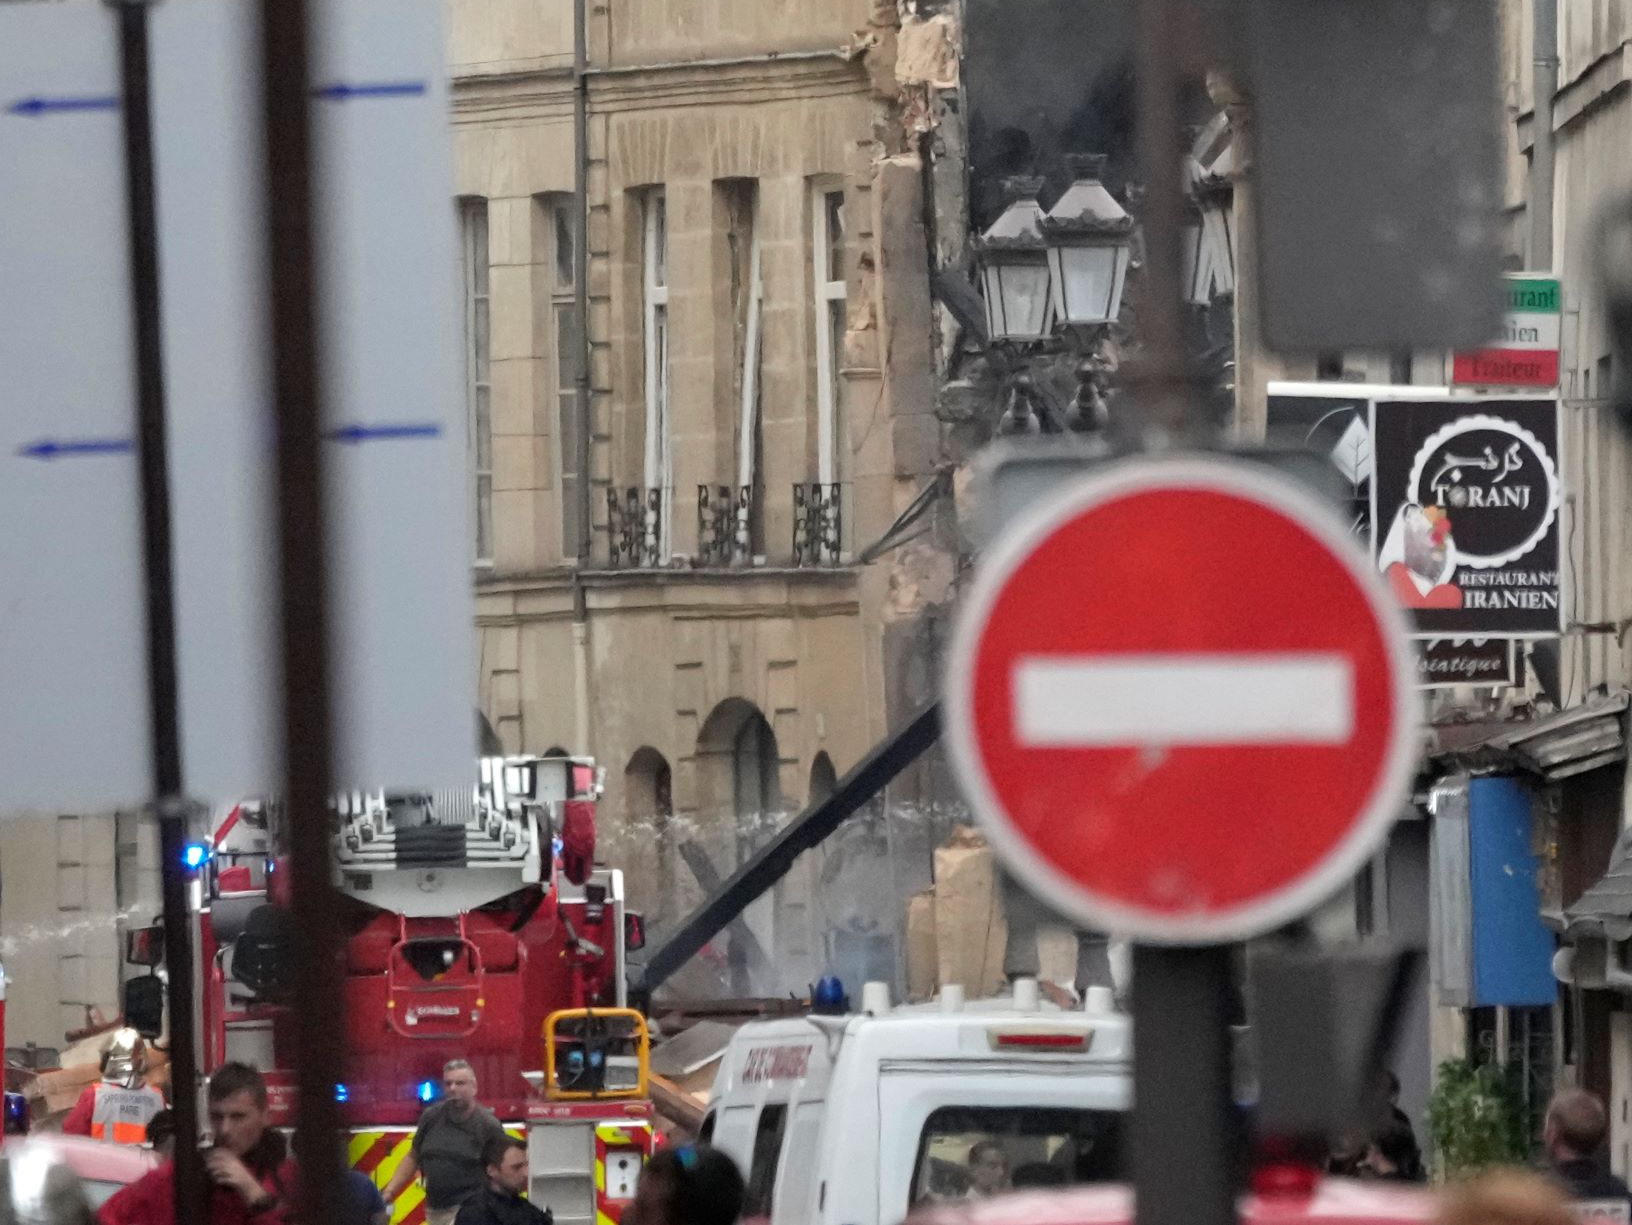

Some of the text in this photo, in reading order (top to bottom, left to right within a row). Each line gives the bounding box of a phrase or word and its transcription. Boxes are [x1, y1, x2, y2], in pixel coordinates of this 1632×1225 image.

[1506, 287, 1556, 308] urant
[1459, 570, 1559, 586] RESTAURANT
[1464, 589, 1558, 609] IRANIEN
[1418, 657, 1501, 677] siatique
